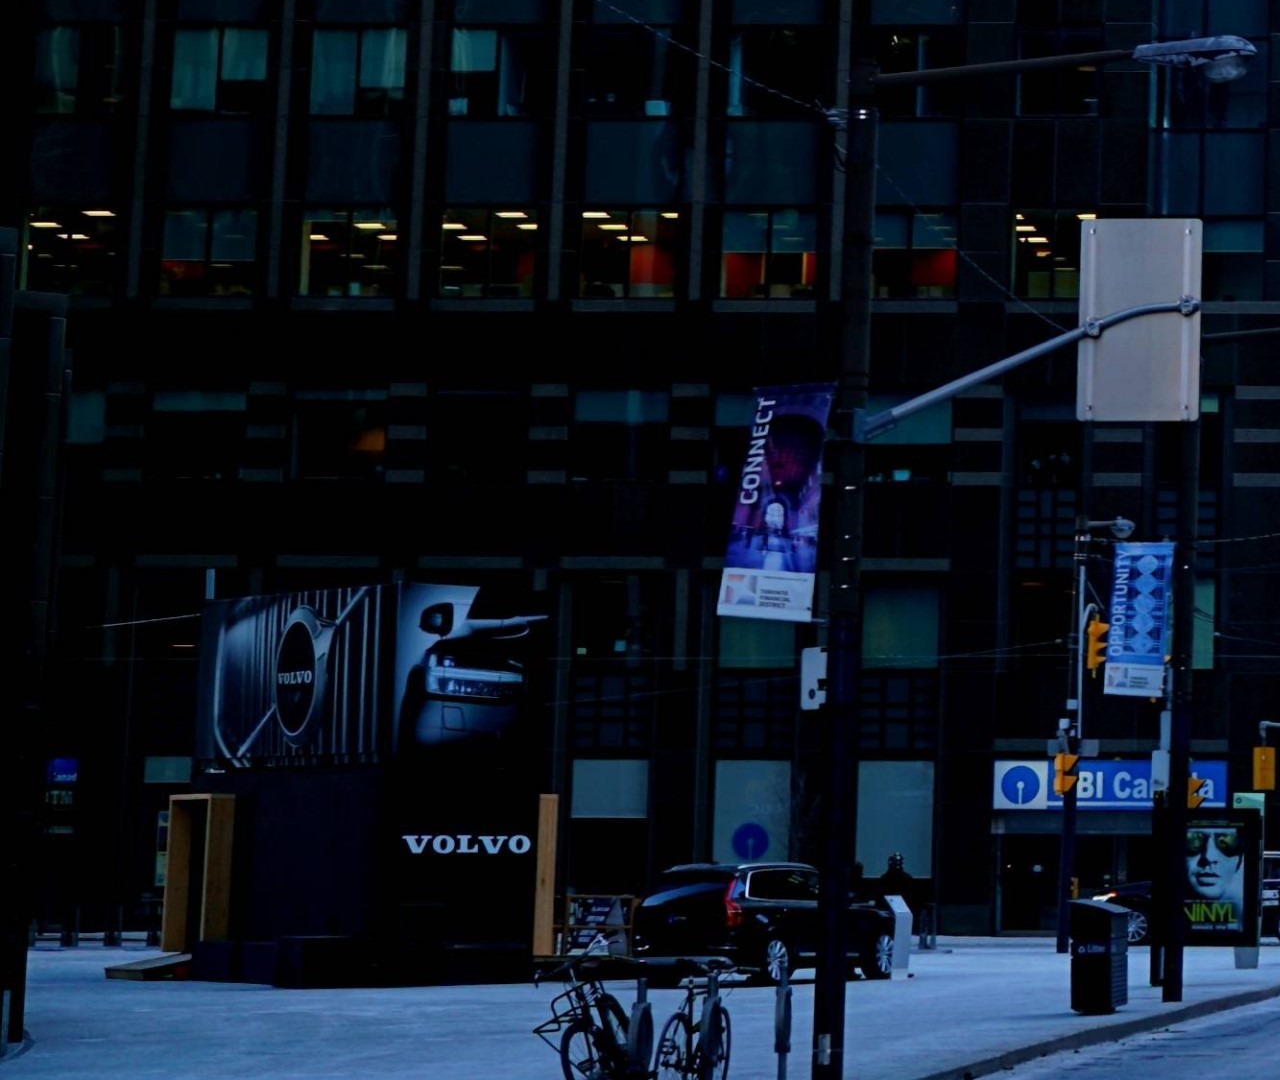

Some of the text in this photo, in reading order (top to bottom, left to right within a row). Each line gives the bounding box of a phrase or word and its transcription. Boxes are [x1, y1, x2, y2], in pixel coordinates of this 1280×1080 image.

[740, 397, 776, 505] CONNECT
[1109, 550, 1130, 656] OPPORTUNITY
[278, 669, 312, 685] VOLVO
[402, 834, 531, 854] VOLVO
[1184, 903, 1238, 923] VINYL
